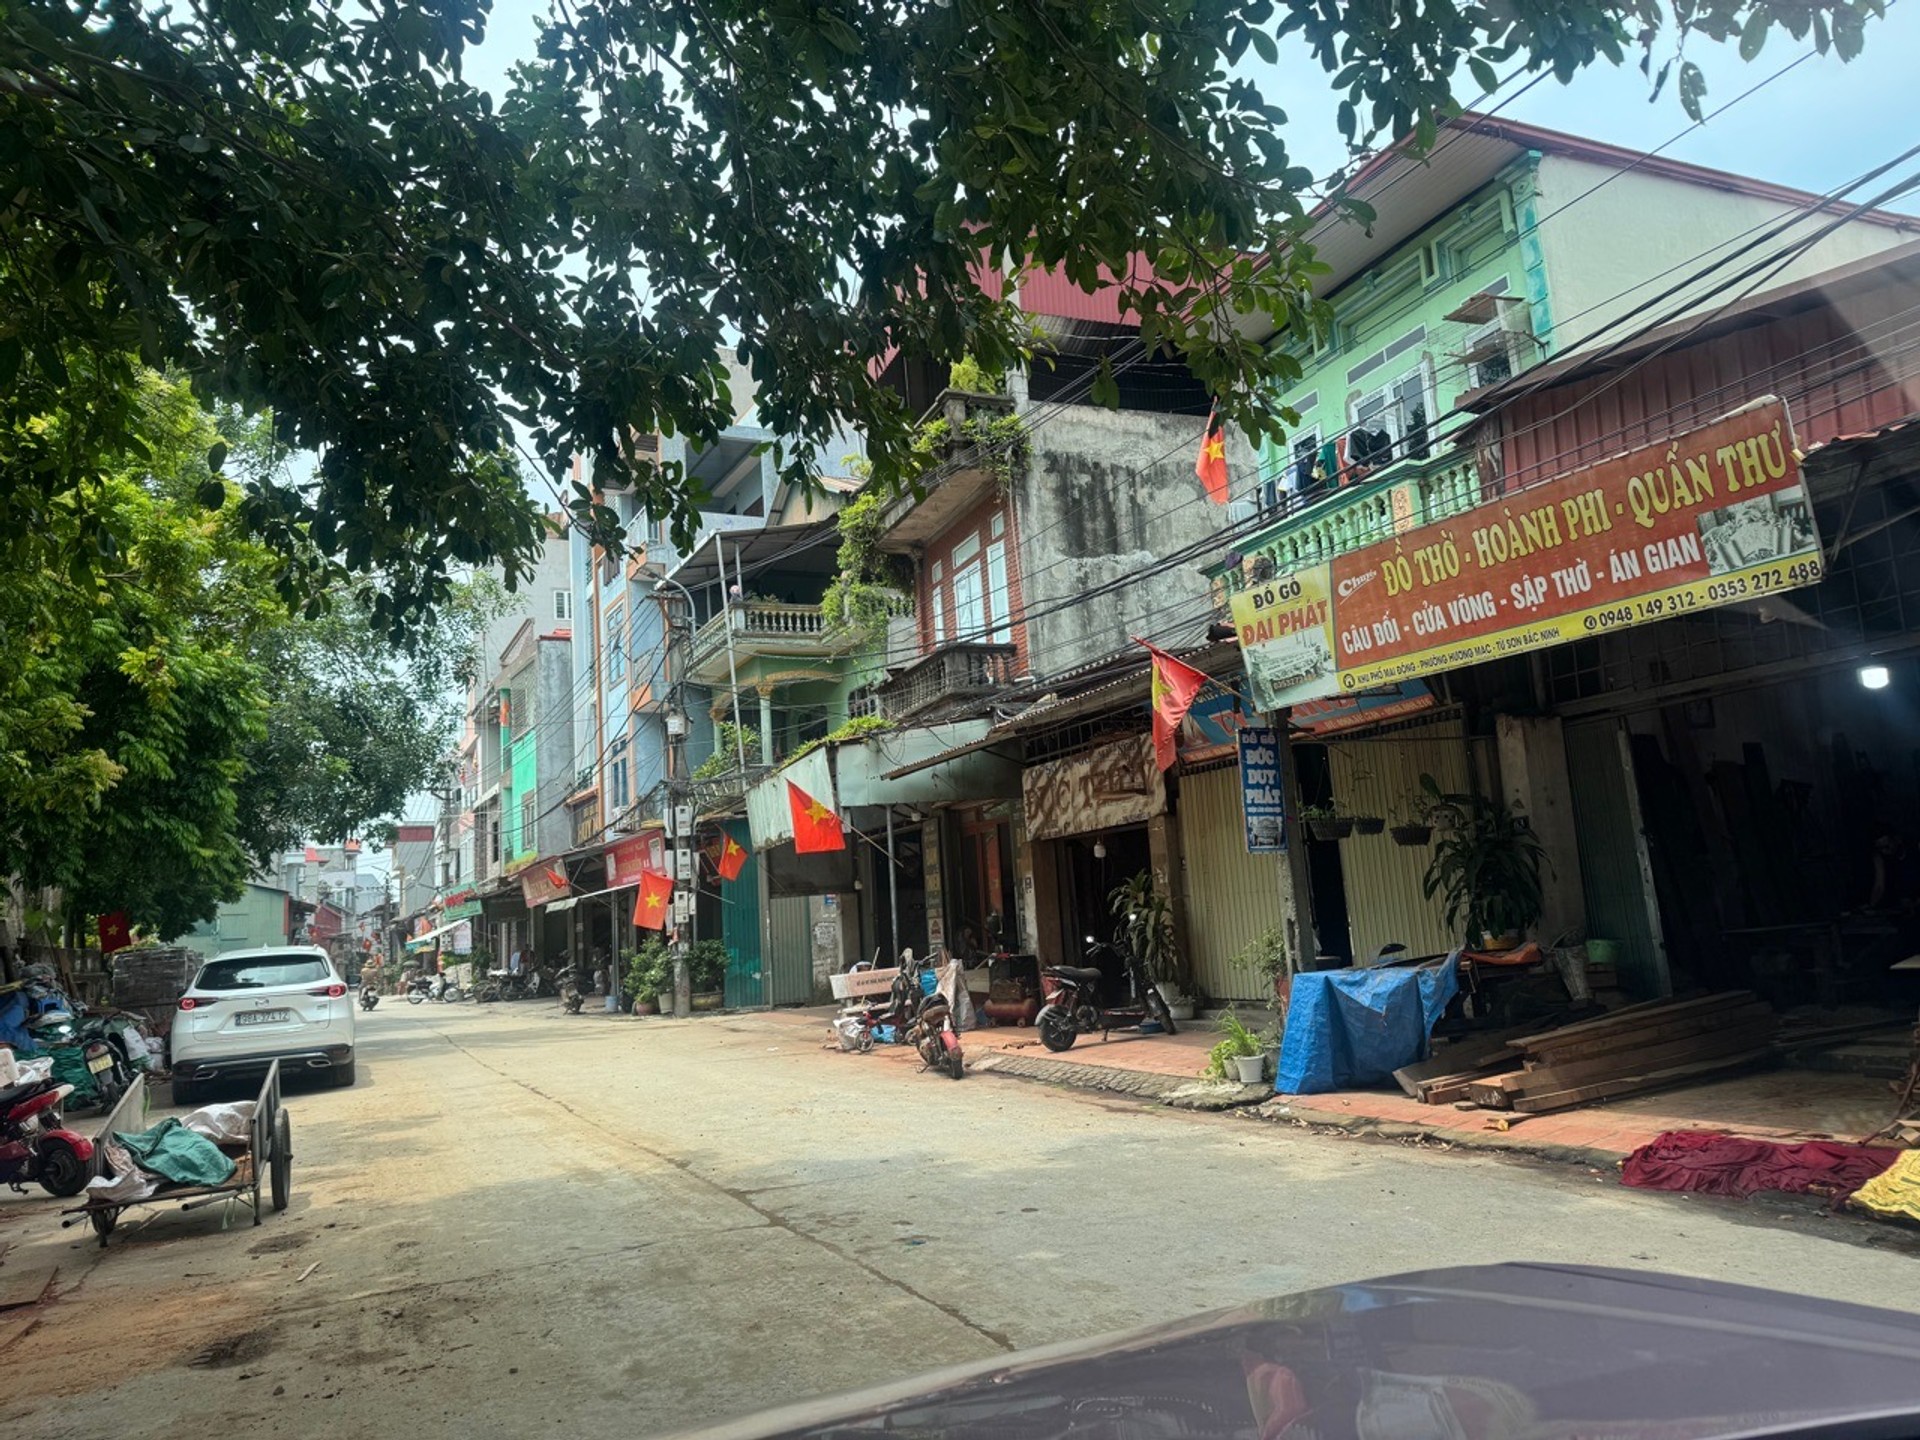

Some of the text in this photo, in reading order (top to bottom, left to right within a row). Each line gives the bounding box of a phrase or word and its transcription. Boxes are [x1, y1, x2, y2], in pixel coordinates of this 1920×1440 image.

[1381, 538, 1413, 597] ĐỒ
[1414, 528, 1460, 587] THỜ
[1472, 505, 1562, 569] HOÀNH
[1561, 488, 1613, 541] PHI
[1627, 441, 1715, 528] QUẤN
[1716, 420, 1787, 492] THƯ
[1252, 577, 1302, 609] ĐỒ GỖ
[1341, 624, 1372, 655] CÂU
[1375, 608, 1402, 646] ĐỐI
[1411, 601, 1448, 636] CỬA
[1449, 590, 1497, 625] VÕNG
[1510, 574, 1548, 612] SẬP
[1551, 556, 1592, 598] THỜ
[1609, 548, 1641, 584] ÁN
[1643, 532, 1701, 573] GIAN
[1599, 606, 1633, 627] 0948
[1636, 600, 1663, 617] 149
[1668, 591, 1696, 611] 312
[1708, 578, 1747, 601] 0353
[1752, 568, 1783, 590] 272
[1788, 560, 1821, 580] 488
[1242, 598, 1328, 648] ĐẠI PHÁT
[1540, 627, 1560, 642] NINH
[1245, 785, 1281, 804] PHÁT
[1247, 769, 1276, 784] DUY
